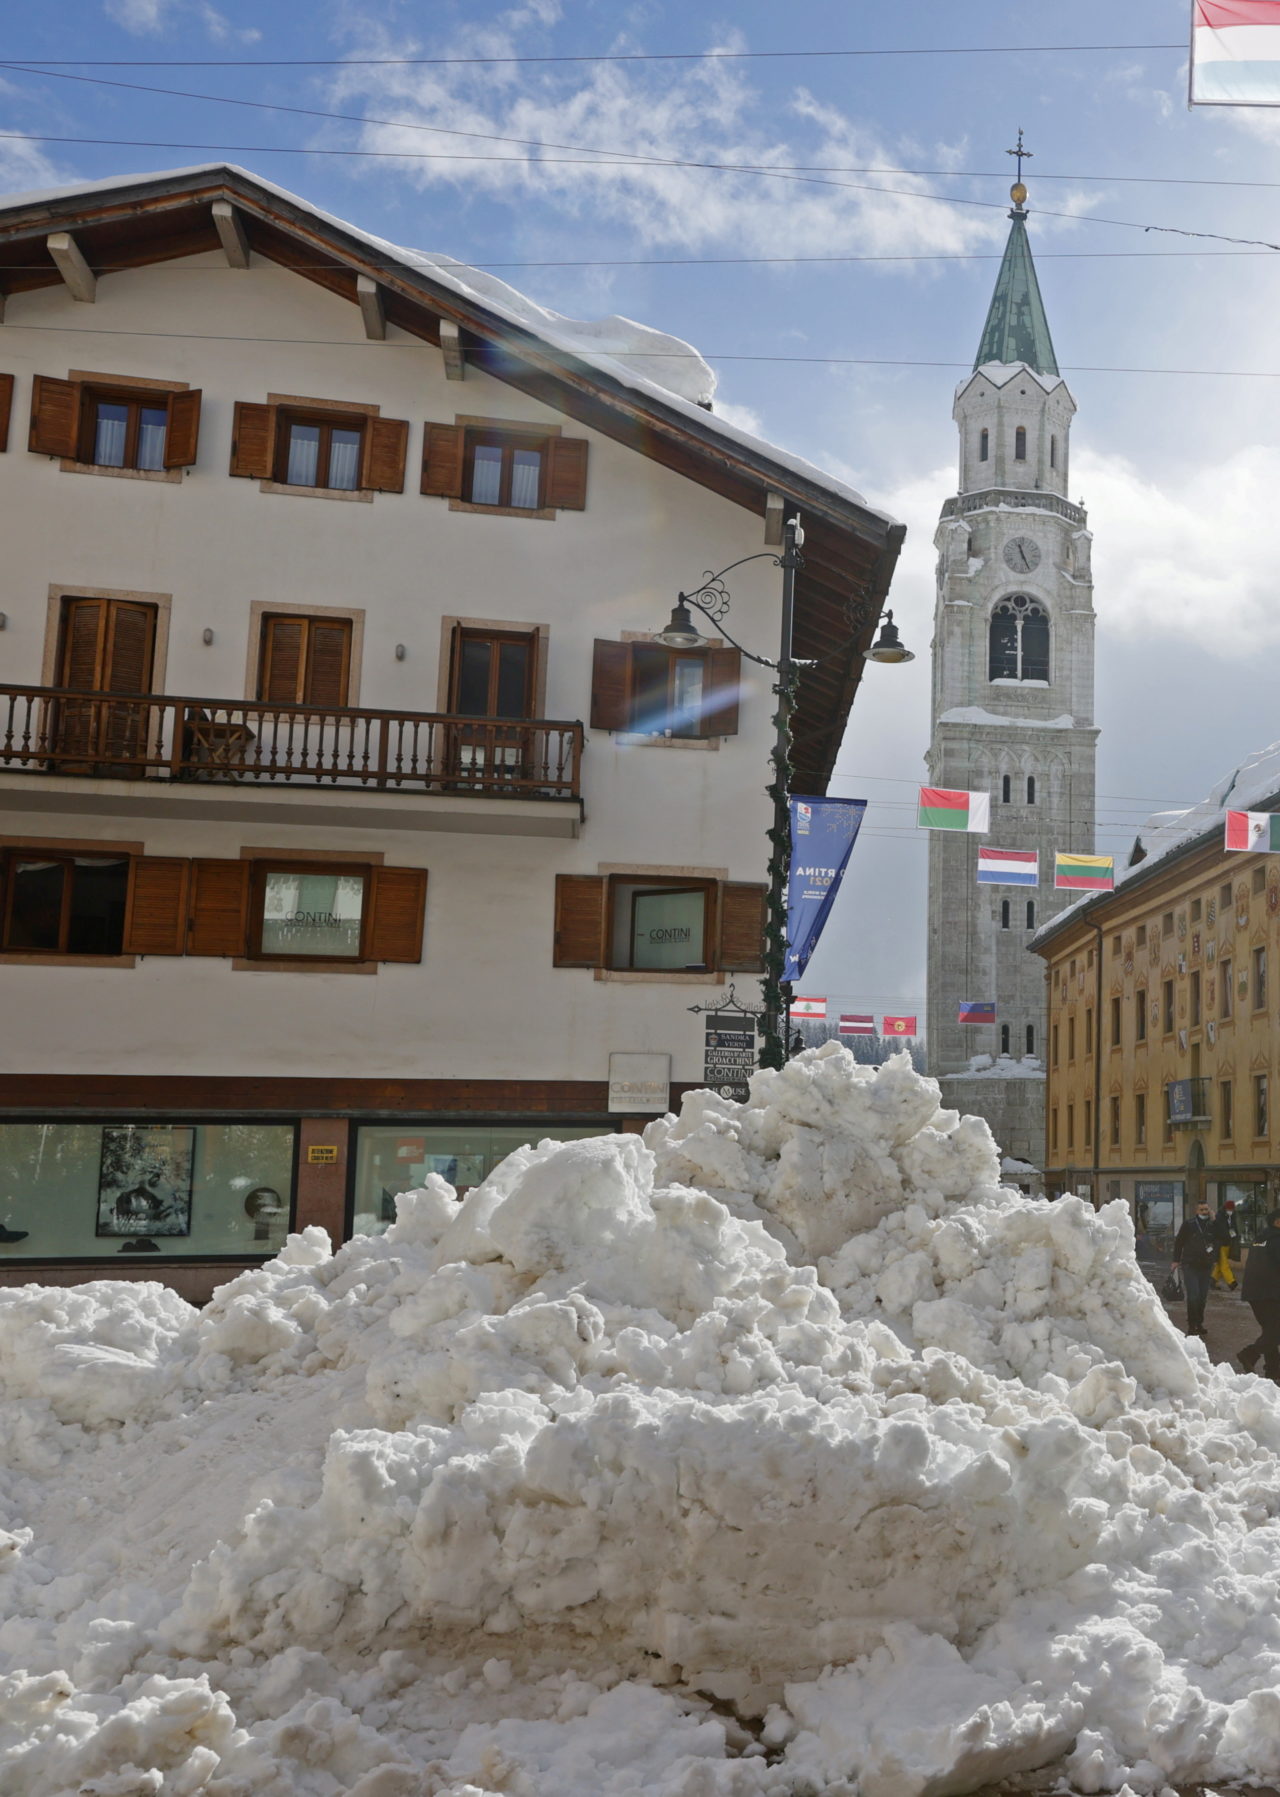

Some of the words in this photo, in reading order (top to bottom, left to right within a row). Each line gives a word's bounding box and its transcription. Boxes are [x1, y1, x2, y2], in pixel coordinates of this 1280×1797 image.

[286, 911, 342, 923] CONTINI
[649, 927, 691, 940] CONTINI
[707, 1056, 753, 1065] GIOACCHINI
[707, 1067, 752, 1079] CONTINI
[611, 1081, 669, 1095] CONTINI
